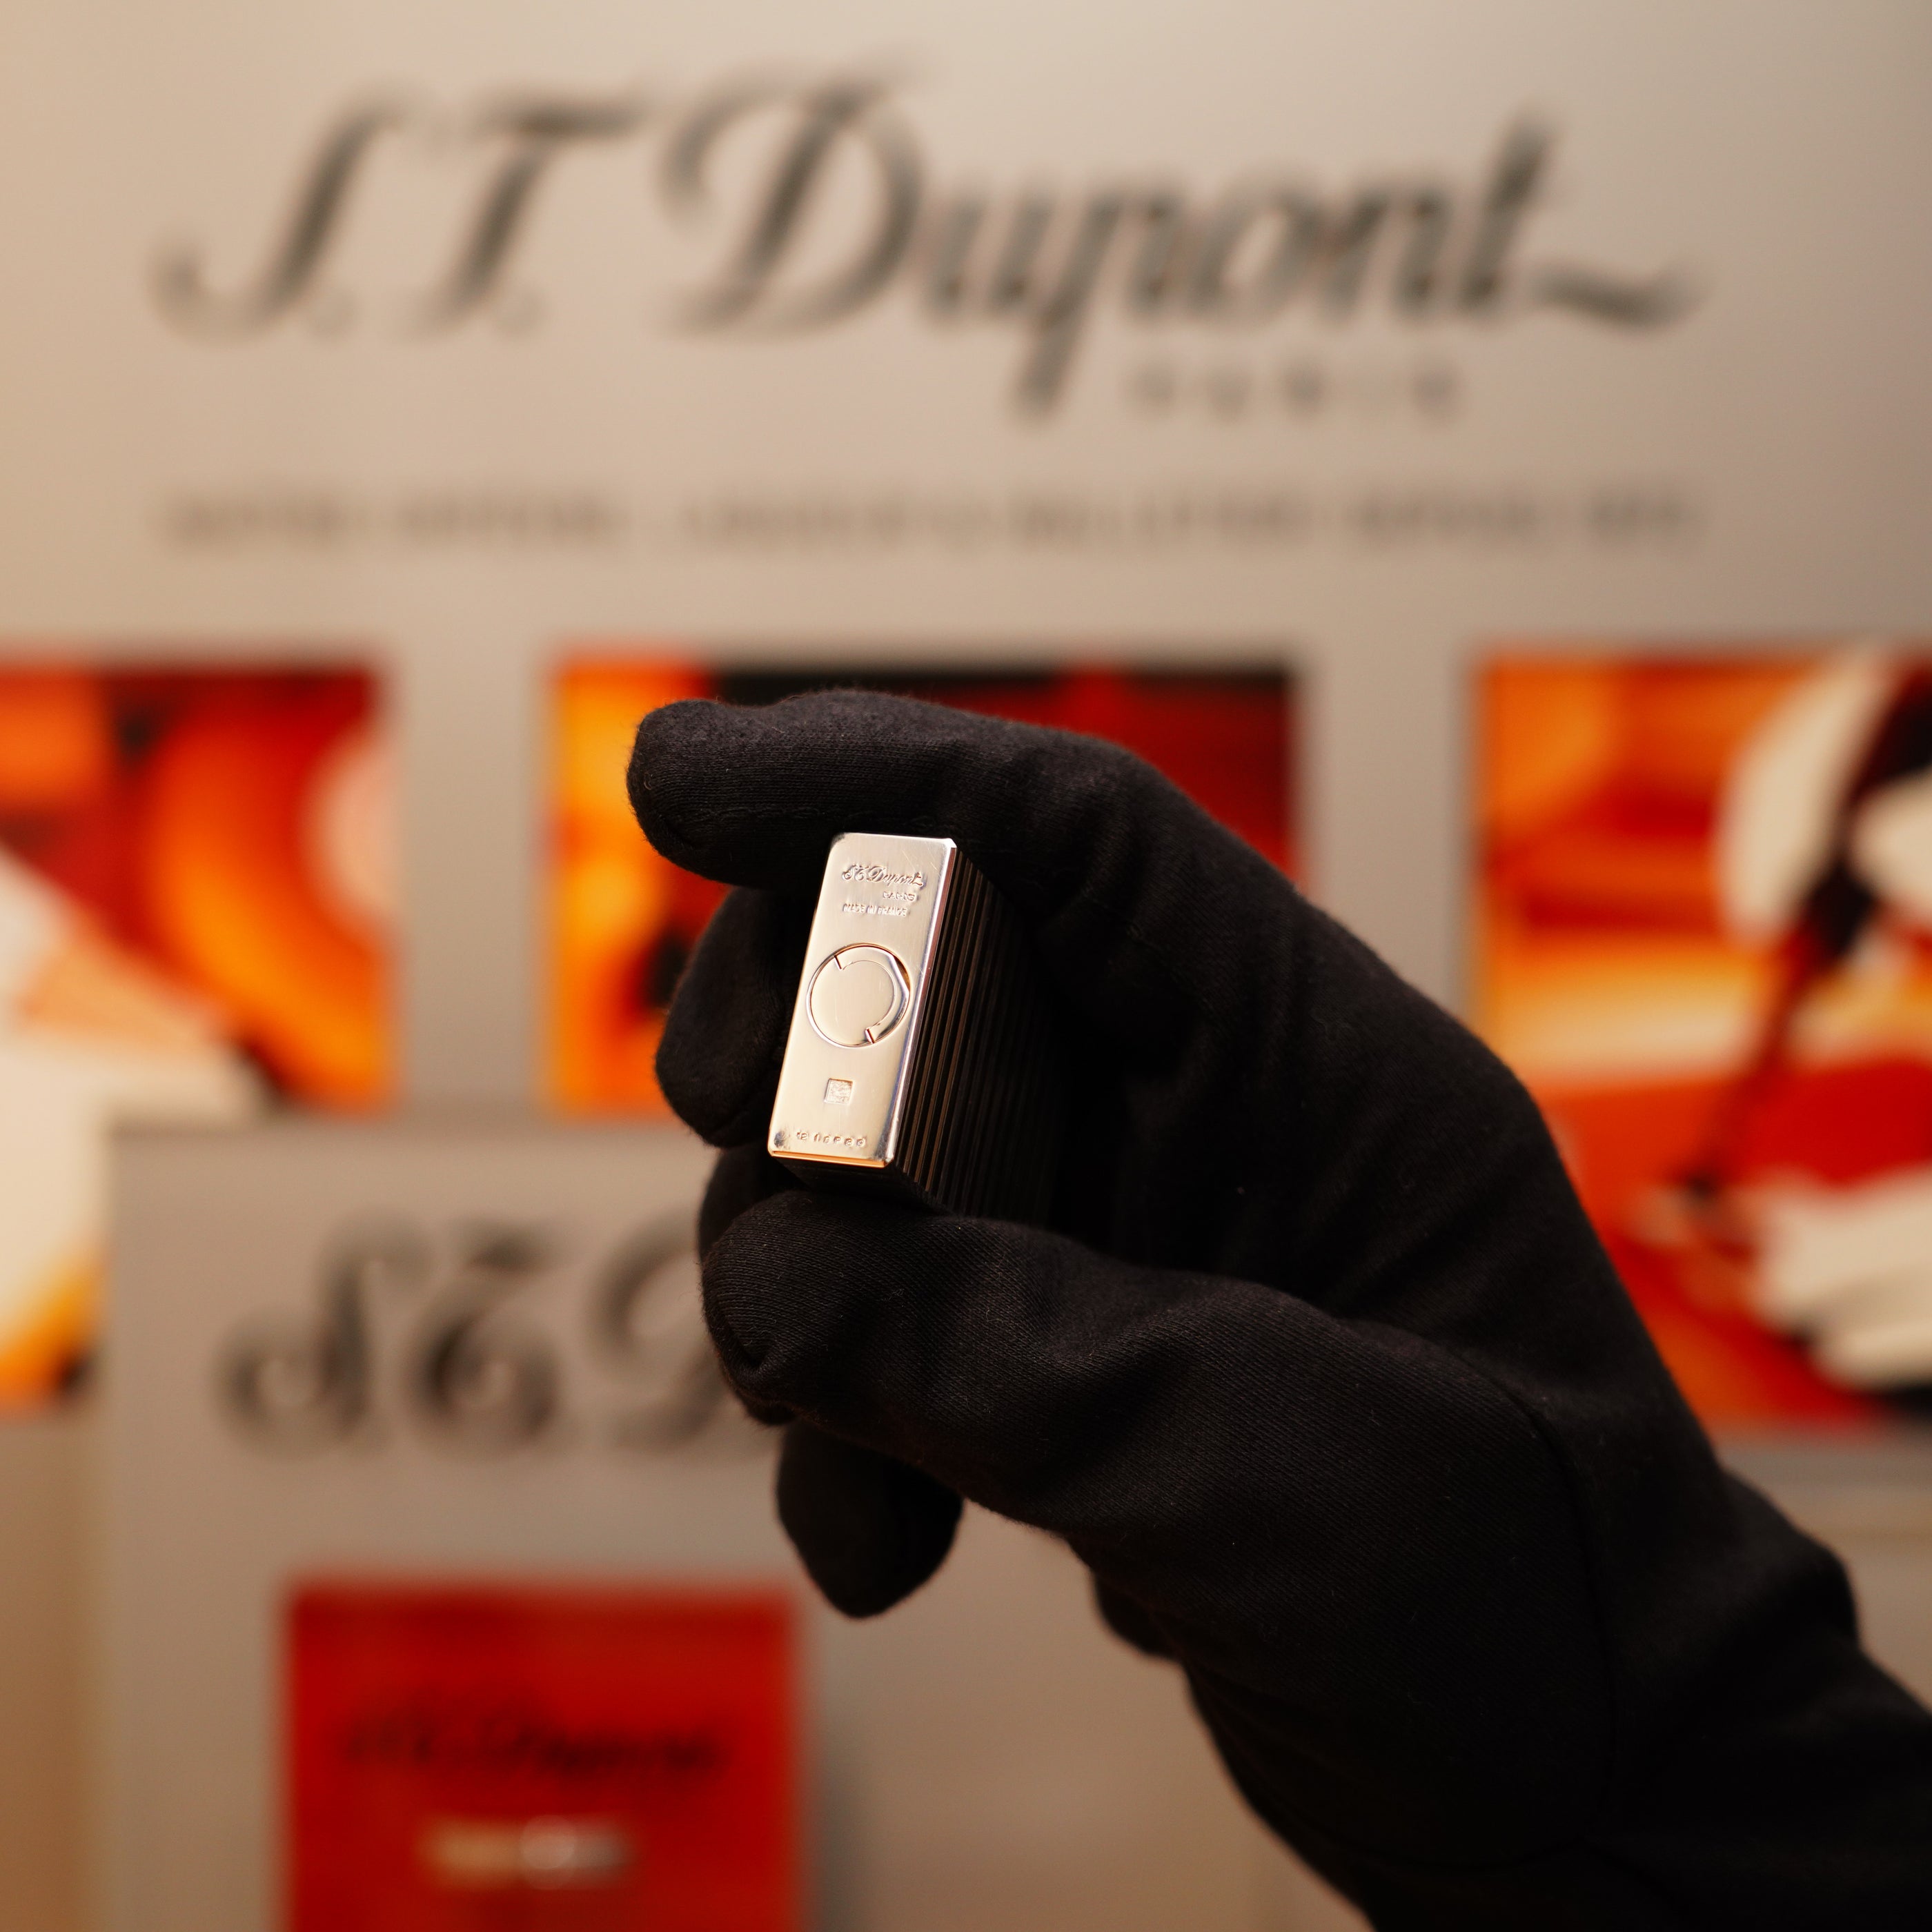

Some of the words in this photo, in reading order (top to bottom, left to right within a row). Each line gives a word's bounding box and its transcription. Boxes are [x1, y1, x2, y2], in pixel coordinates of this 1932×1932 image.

[659, 59, 1701, 421] Dupont
[867, 865, 923, 887] Dupont
[883, 891, 916, 902] PARIS
[842, 903, 865, 914] MADE
[866, 905, 876, 915] IN
[877, 905, 907, 917] FRANCE
